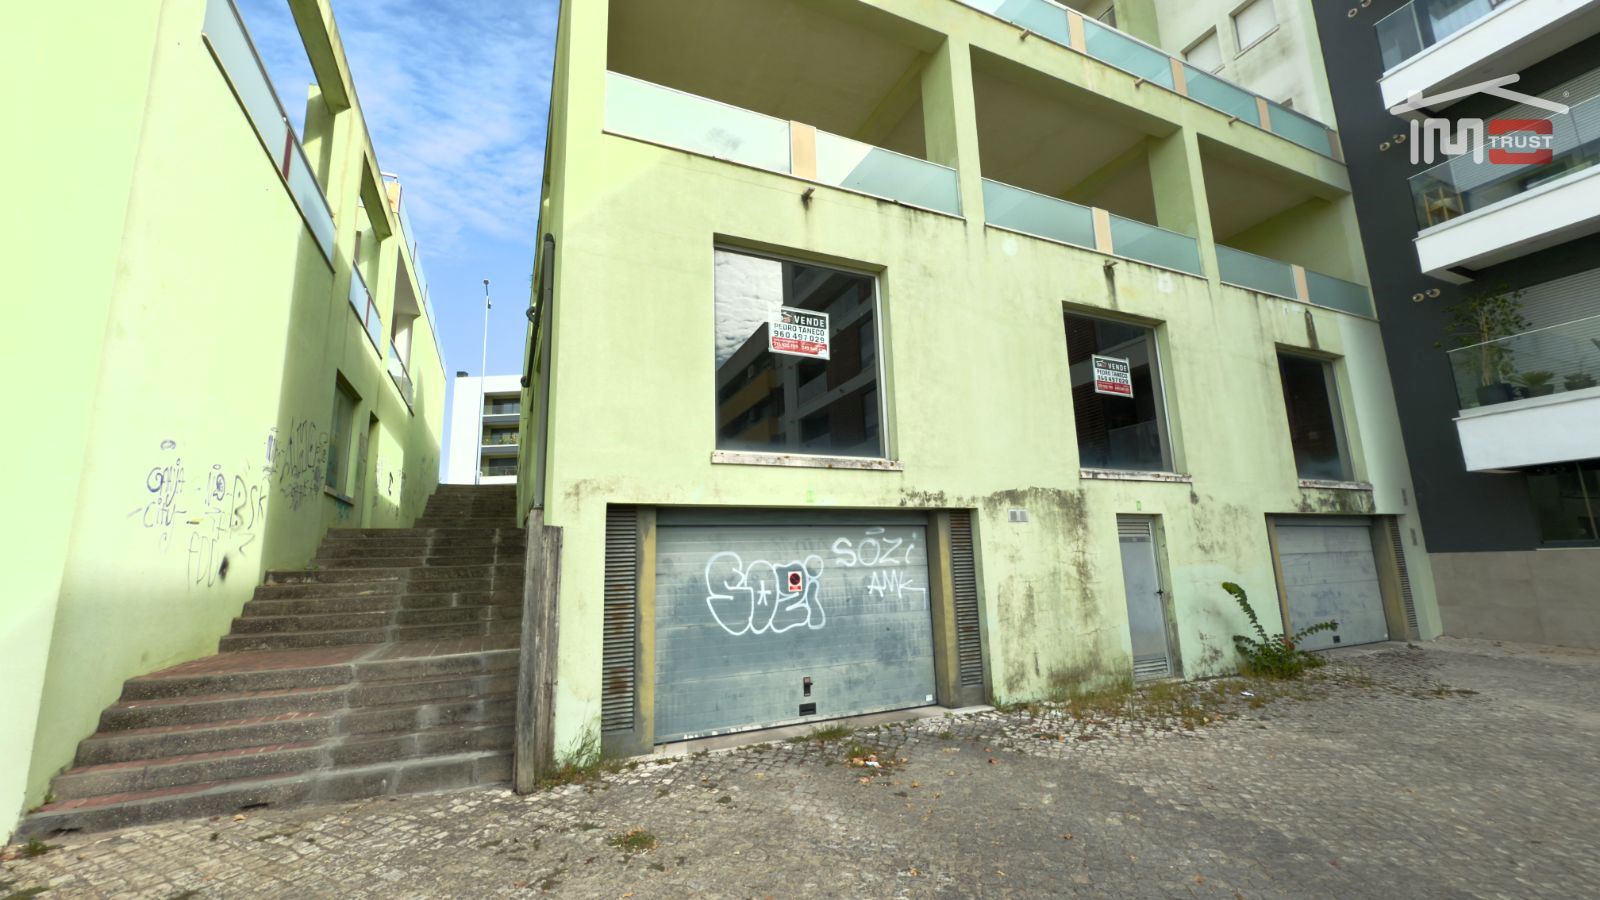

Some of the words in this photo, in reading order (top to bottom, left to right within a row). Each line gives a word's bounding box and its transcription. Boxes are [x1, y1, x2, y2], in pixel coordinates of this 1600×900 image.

[794, 315, 825, 328] VENDE
[773, 323, 797, 332] PEDRO
[1108, 362, 1128, 372] VENDE
